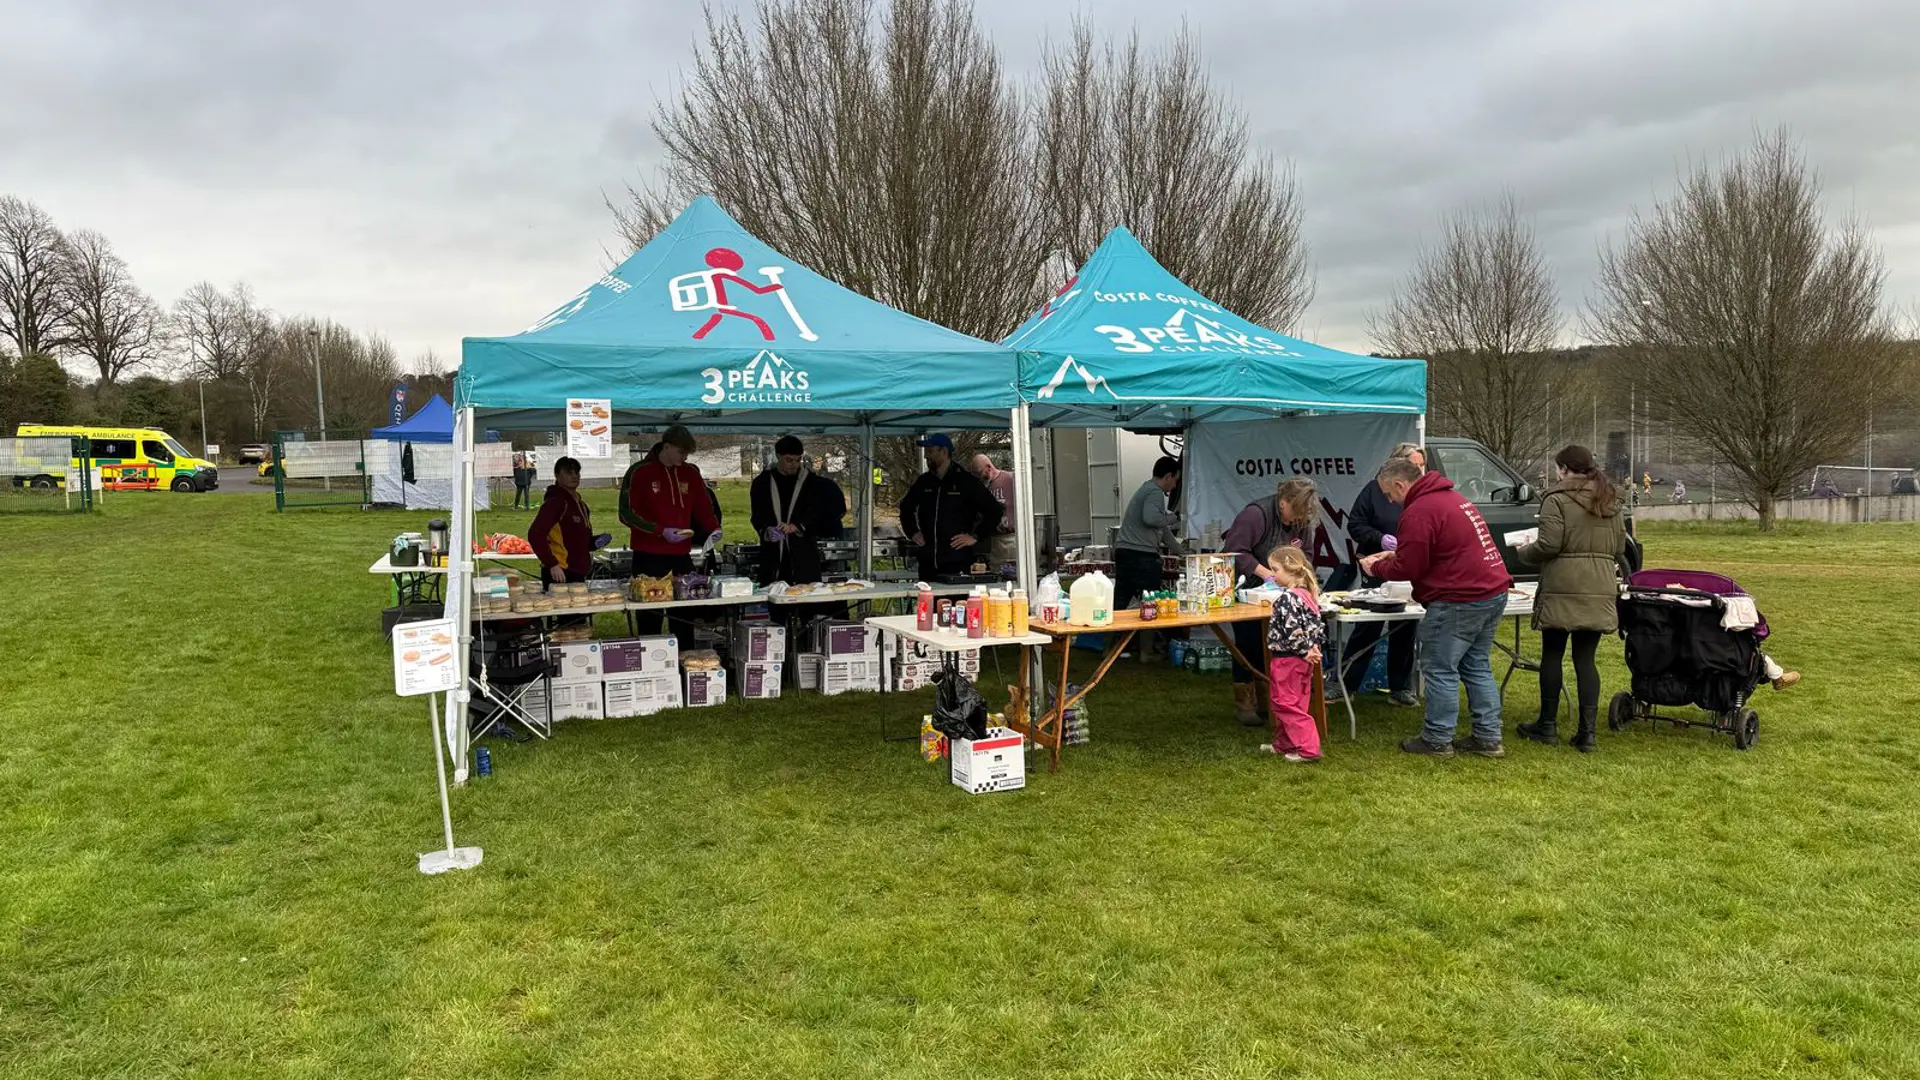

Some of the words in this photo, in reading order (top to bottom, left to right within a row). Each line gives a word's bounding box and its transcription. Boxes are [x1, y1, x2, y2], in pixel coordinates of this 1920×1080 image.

[1093, 290, 1152, 303] COSTA
[1155, 292, 1223, 314] COFFEE
[1093, 325, 1154, 353] 3
[1139, 321, 1286, 350] PEAKS
[700, 367, 726, 405] 3
[727, 361, 810, 390] PEAKS
[727, 392, 812, 403] CHALLENGE
[1235, 458, 1285, 477] COSTA
[1290, 457, 1356, 475] COFFEE
